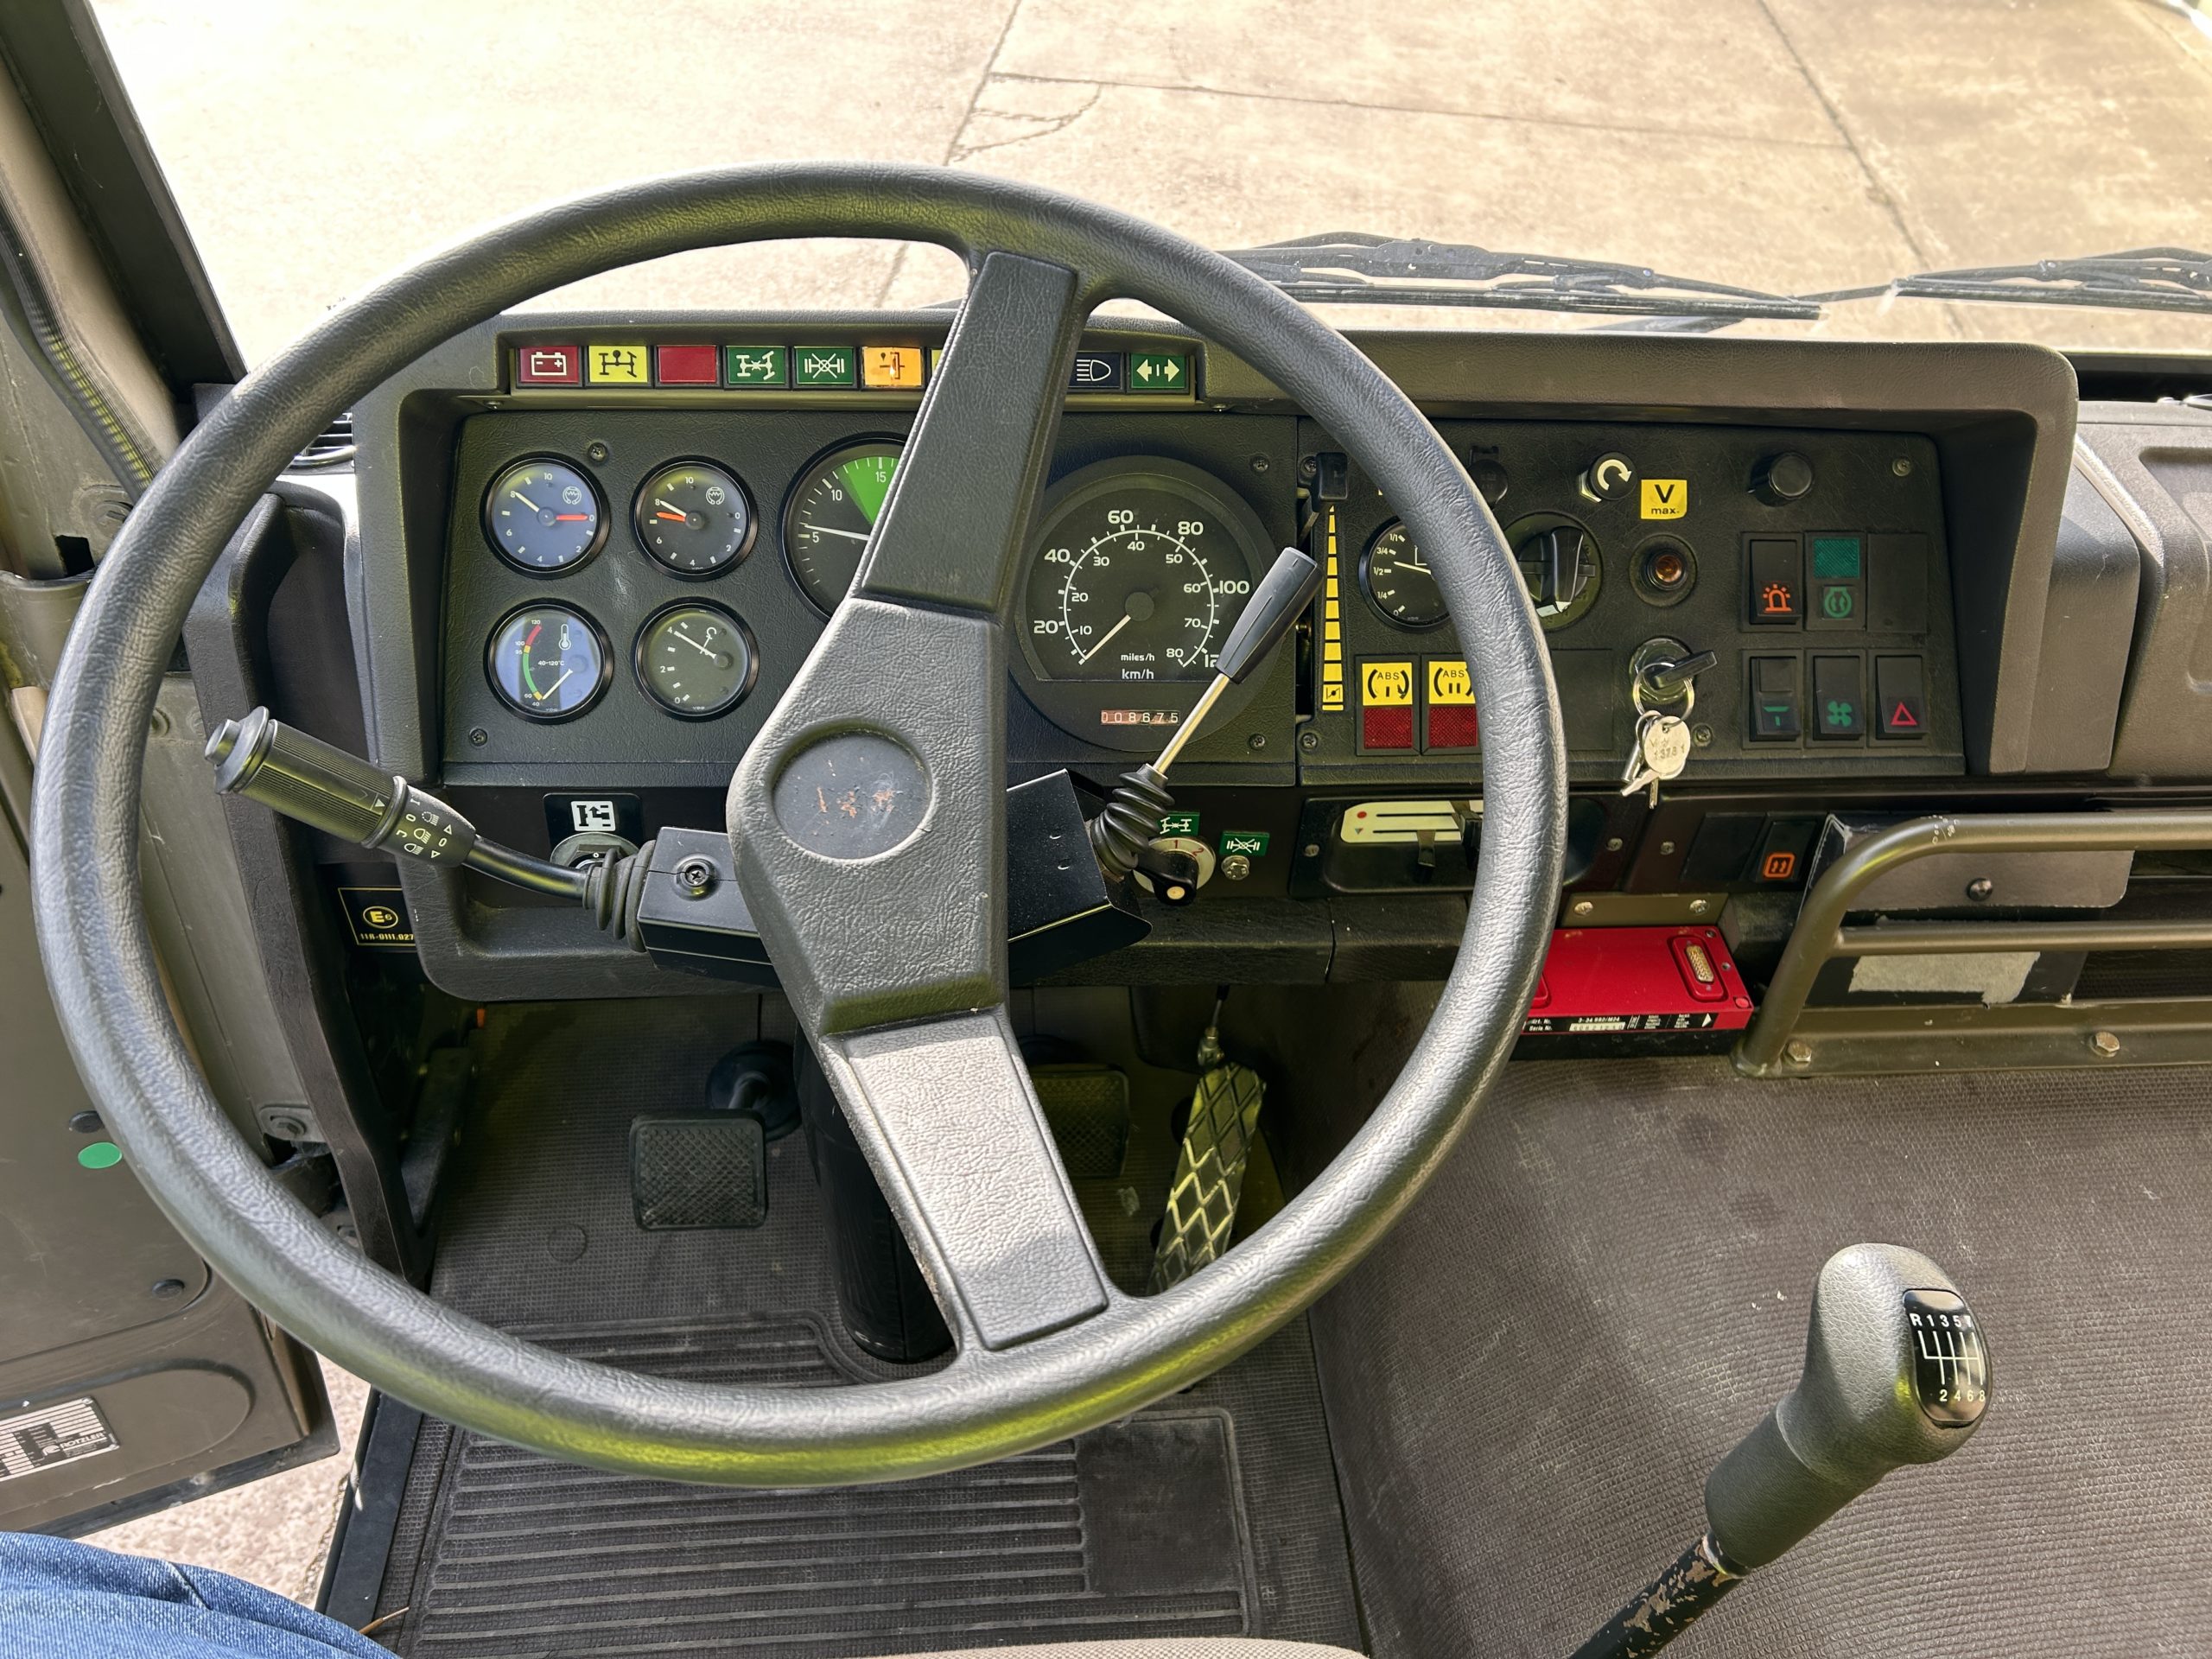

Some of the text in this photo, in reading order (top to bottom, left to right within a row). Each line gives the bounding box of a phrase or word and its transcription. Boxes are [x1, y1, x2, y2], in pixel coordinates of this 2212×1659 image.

[875, 472, 887, 482] 15
[831, 489, 842, 501] 10
[1654, 484, 1676, 504] V
[1108, 510, 1134, 524] 60
[1177, 521, 1204, 536] 80
[812, 531, 819, 543] 5
[1127, 541, 1145, 551] 40
[1376, 546, 1388, 555] 3/4
[1044, 549, 1071, 563] 40
[1165, 554, 1183, 563] 50
[1093, 556, 1110, 567] 30
[1374, 567, 1384, 575] 1/2
[1184, 583, 1201, 594] 60
[1219, 581, 1249, 594] 100
[1071, 593, 1089, 602] 20
[1377, 591, 1388, 600] 1/4
[1033, 620, 1058, 634] 20
[1184, 618, 1201, 627] 70
[667, 626, 673, 634] 4
[1080, 626, 1092, 636] 10
[1120, 652, 1154, 662] miles/h
[1166, 648, 1184, 658] 80
[1122, 669, 1154, 680] km/h
[1377, 671, 1400, 681] ABS
[1443, 670, 1465, 678] ABS
[1173, 840, 1179, 849] 1
[1192, 847, 1204, 856] 2
[1910, 1313, 1923, 1327] R
[1926, 1315, 1936, 1327] 1
[1939, 1315, 1949, 1327] 3
[1953, 1315, 1961, 1328] 5
[1939, 1389, 1986, 1402] 2 4 6 8
[60, 1433, 105, 1449] ROTZLER
